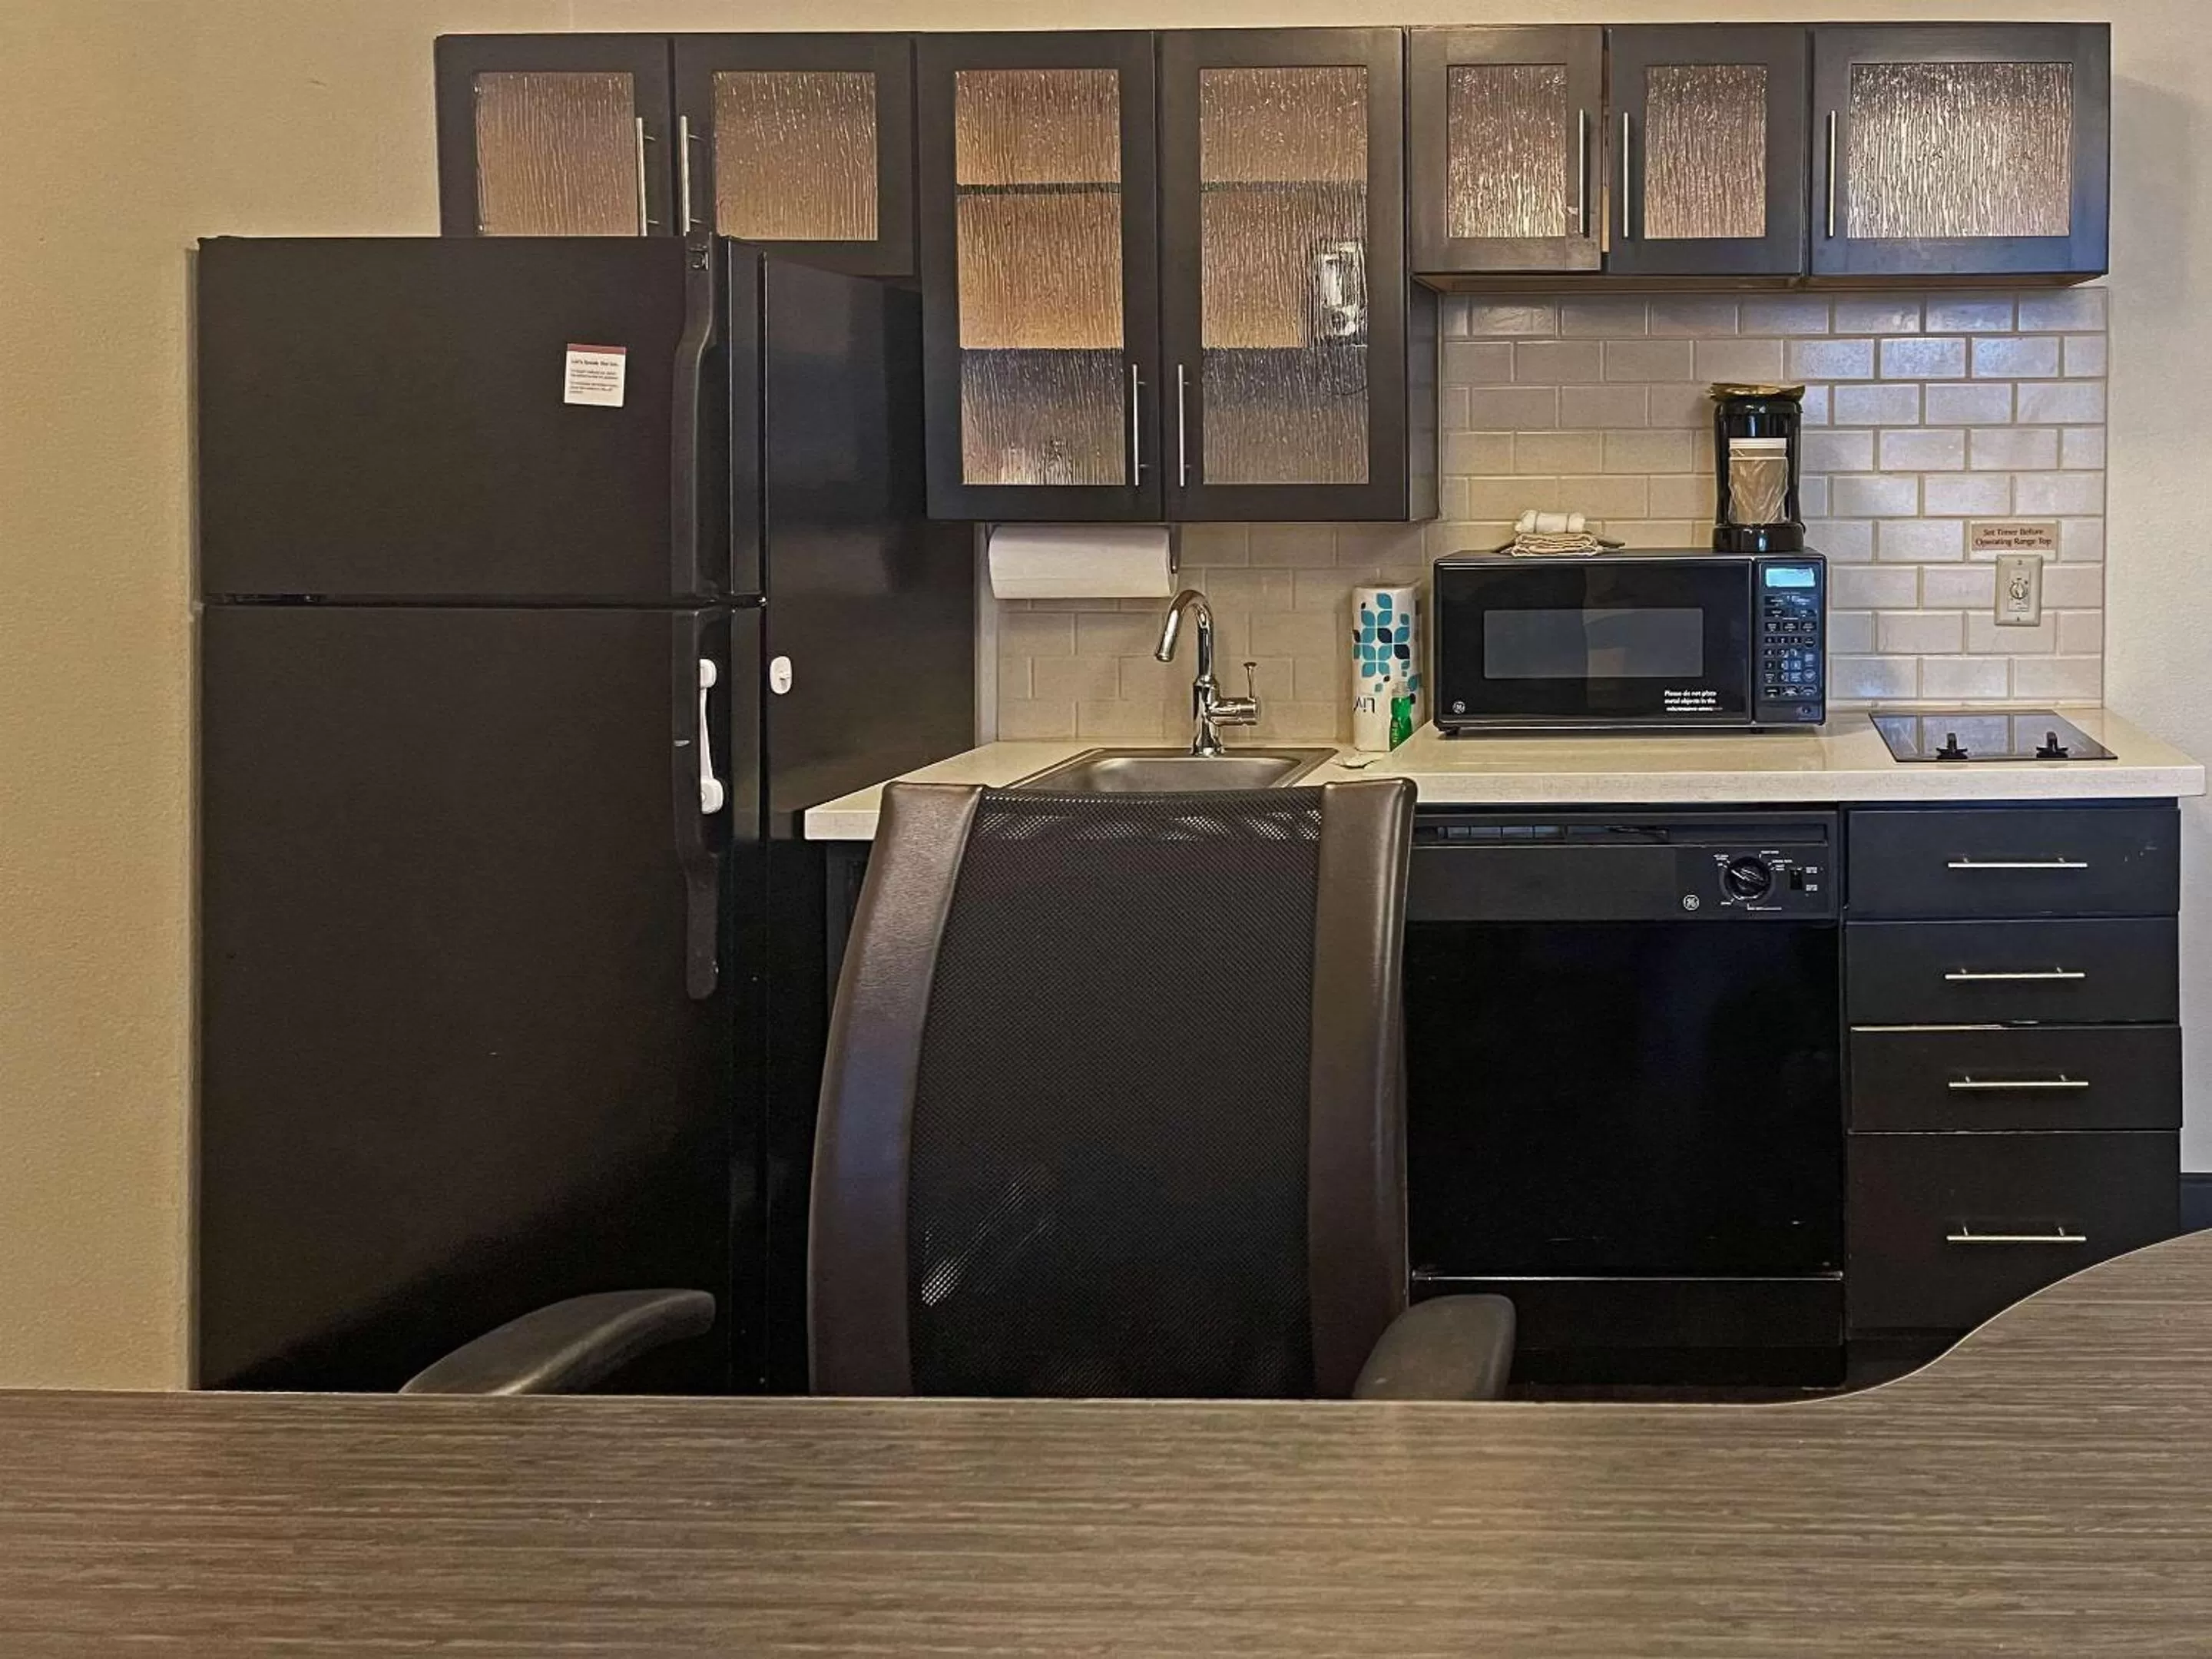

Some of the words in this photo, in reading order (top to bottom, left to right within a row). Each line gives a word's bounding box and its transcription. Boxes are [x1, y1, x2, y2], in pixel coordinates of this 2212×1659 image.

[1975, 538, 2012, 547] Operating
[2014, 538, 2036, 546] Range
[2038, 538, 2052, 547] Top
